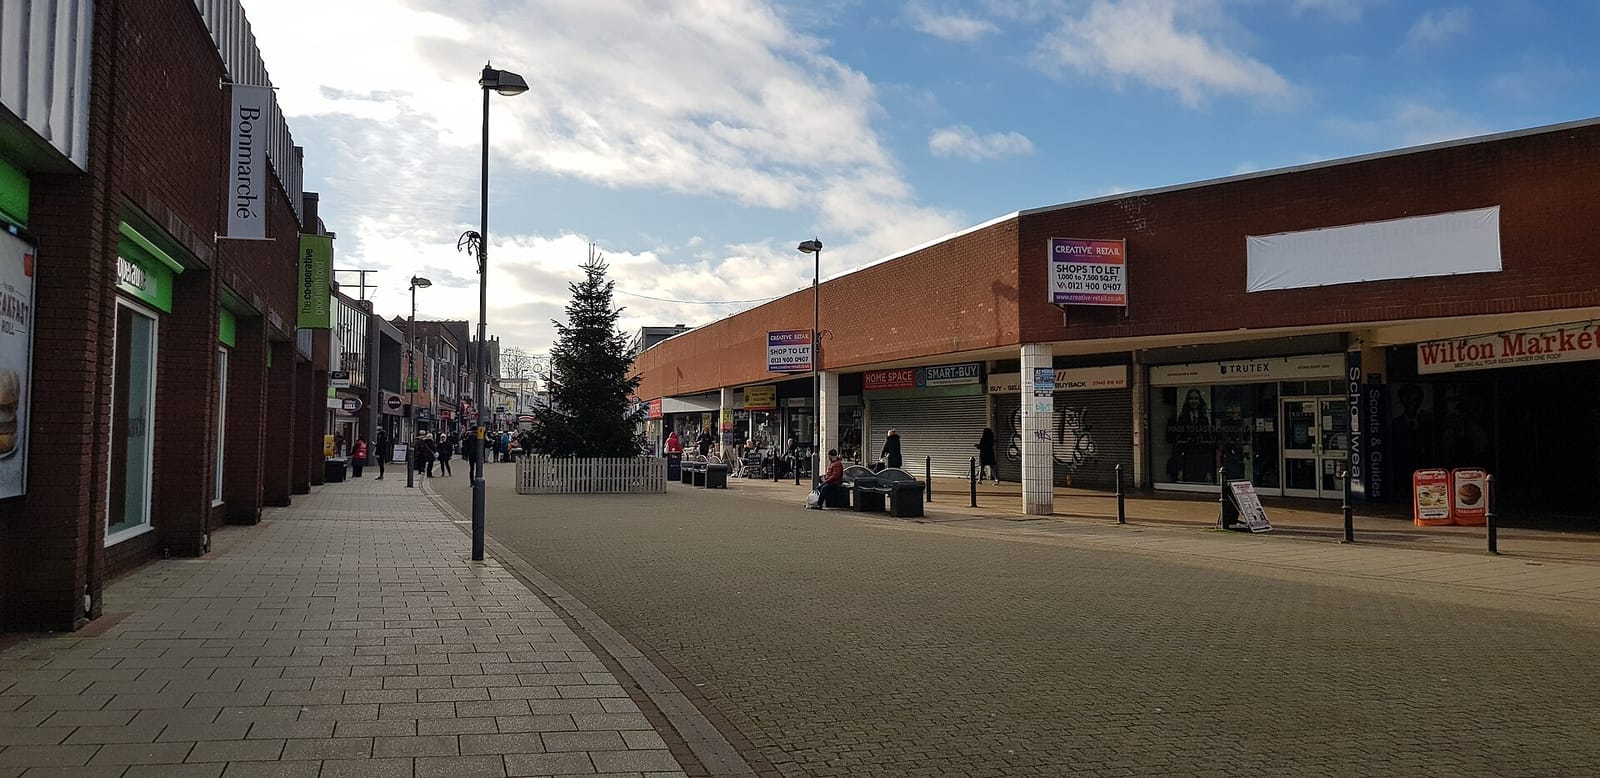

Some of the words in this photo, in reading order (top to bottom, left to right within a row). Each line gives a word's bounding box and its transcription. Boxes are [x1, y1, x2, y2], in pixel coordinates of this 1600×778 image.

[236, 105, 260, 219] Bonmarché
[1055, 245, 1093, 255] CREATIVE
[1096, 247, 1120, 256] RETAIL
[303, 248, 313, 300] co-operative
[314, 262, 324, 279] food
[1056, 264, 1088, 273] SHOPS
[1089, 265, 1103, 274] TO
[1104, 266, 1121, 275] LET
[1067, 281, 1083, 290] 0121
[1085, 282, 1100, 290] 400
[1102, 283, 1121, 291] 0407
[302, 301, 311, 315] The
[1420, 341, 1495, 365] Wilton
[1230, 362, 1270, 373] TRUTEX
[865, 372, 886, 383] HOME
[888, 370, 913, 382] SPACE
[1369, 389, 1381, 433] Scouts
[1370, 437, 1381, 448] &
[1370, 450, 1382, 497] Guides
